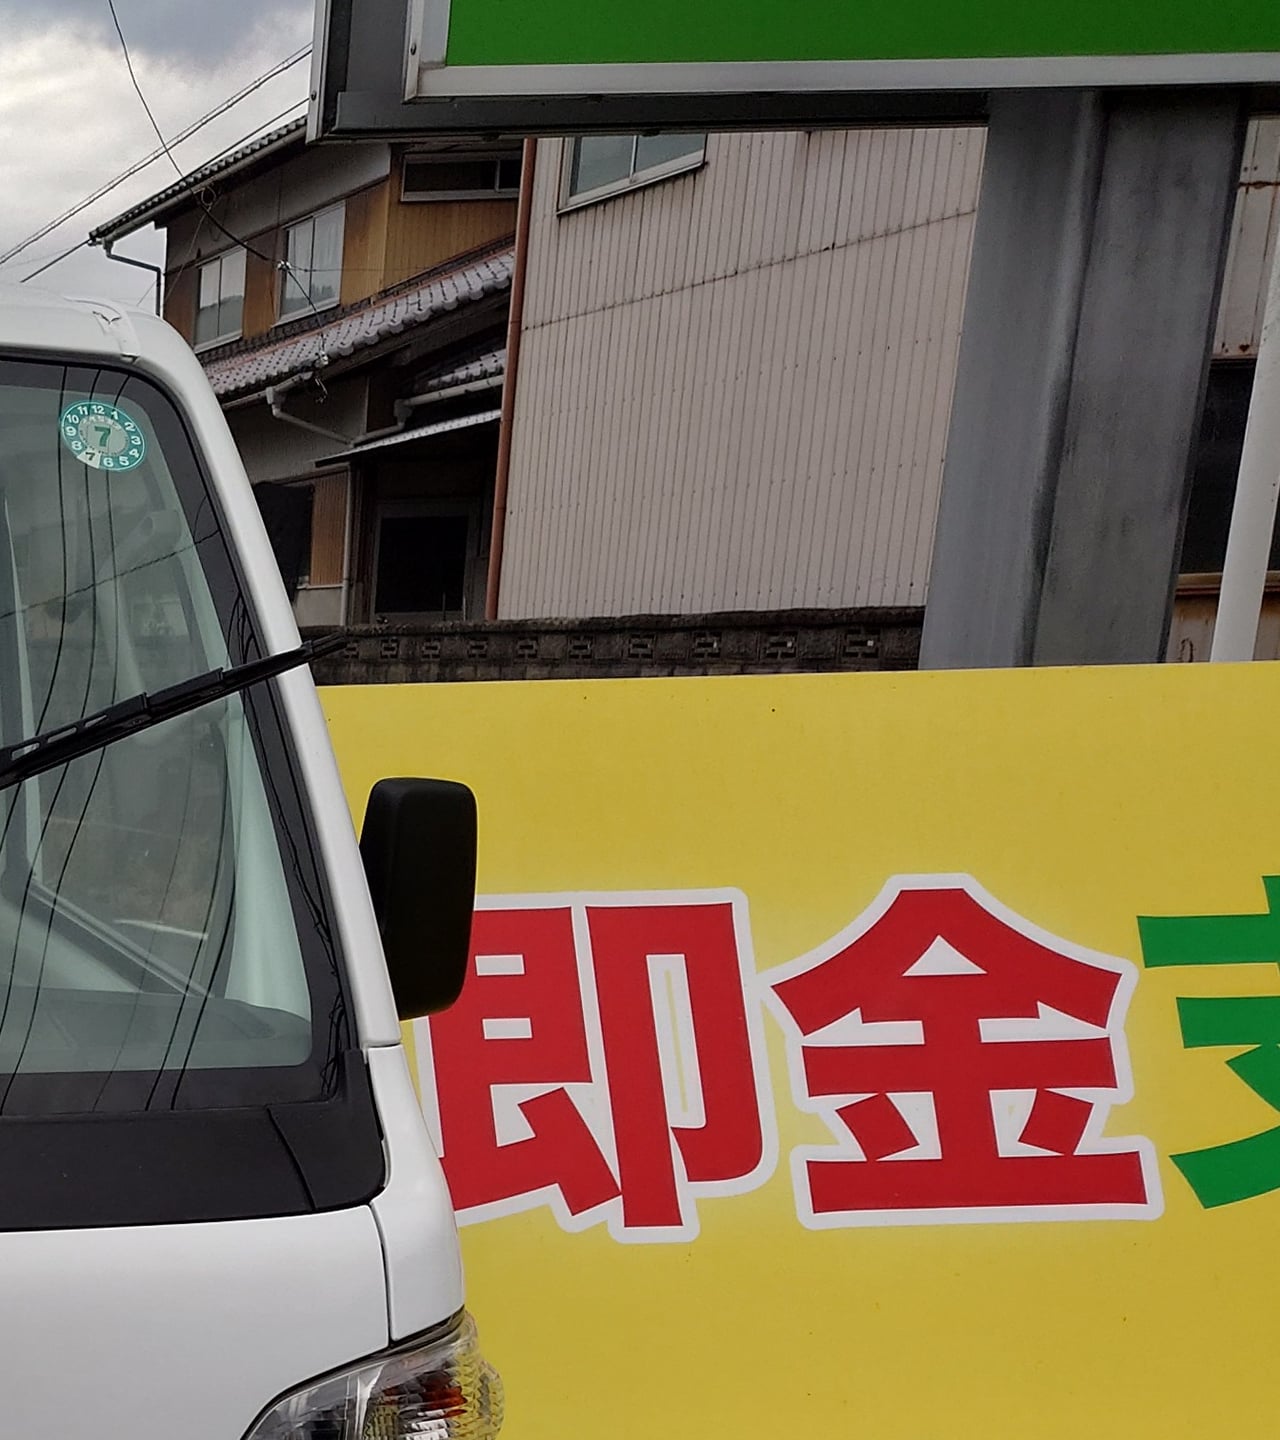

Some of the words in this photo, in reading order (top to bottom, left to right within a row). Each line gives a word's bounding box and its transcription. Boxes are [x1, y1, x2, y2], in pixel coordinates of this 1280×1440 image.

[91, 405, 105, 415] 12
[66, 414, 80, 424] 10
[111, 411, 119, 420] 1
[65, 426, 77, 437] 9
[124, 422, 135, 432] 2
[94, 426, 111, 447] 7
[131, 436, 141, 446] 3
[71, 441, 82, 451] 8
[85, 451, 96, 461] 7
[129, 449, 139, 459] 4
[103, 457, 114, 468] 6
[119, 456, 129, 466] 5
